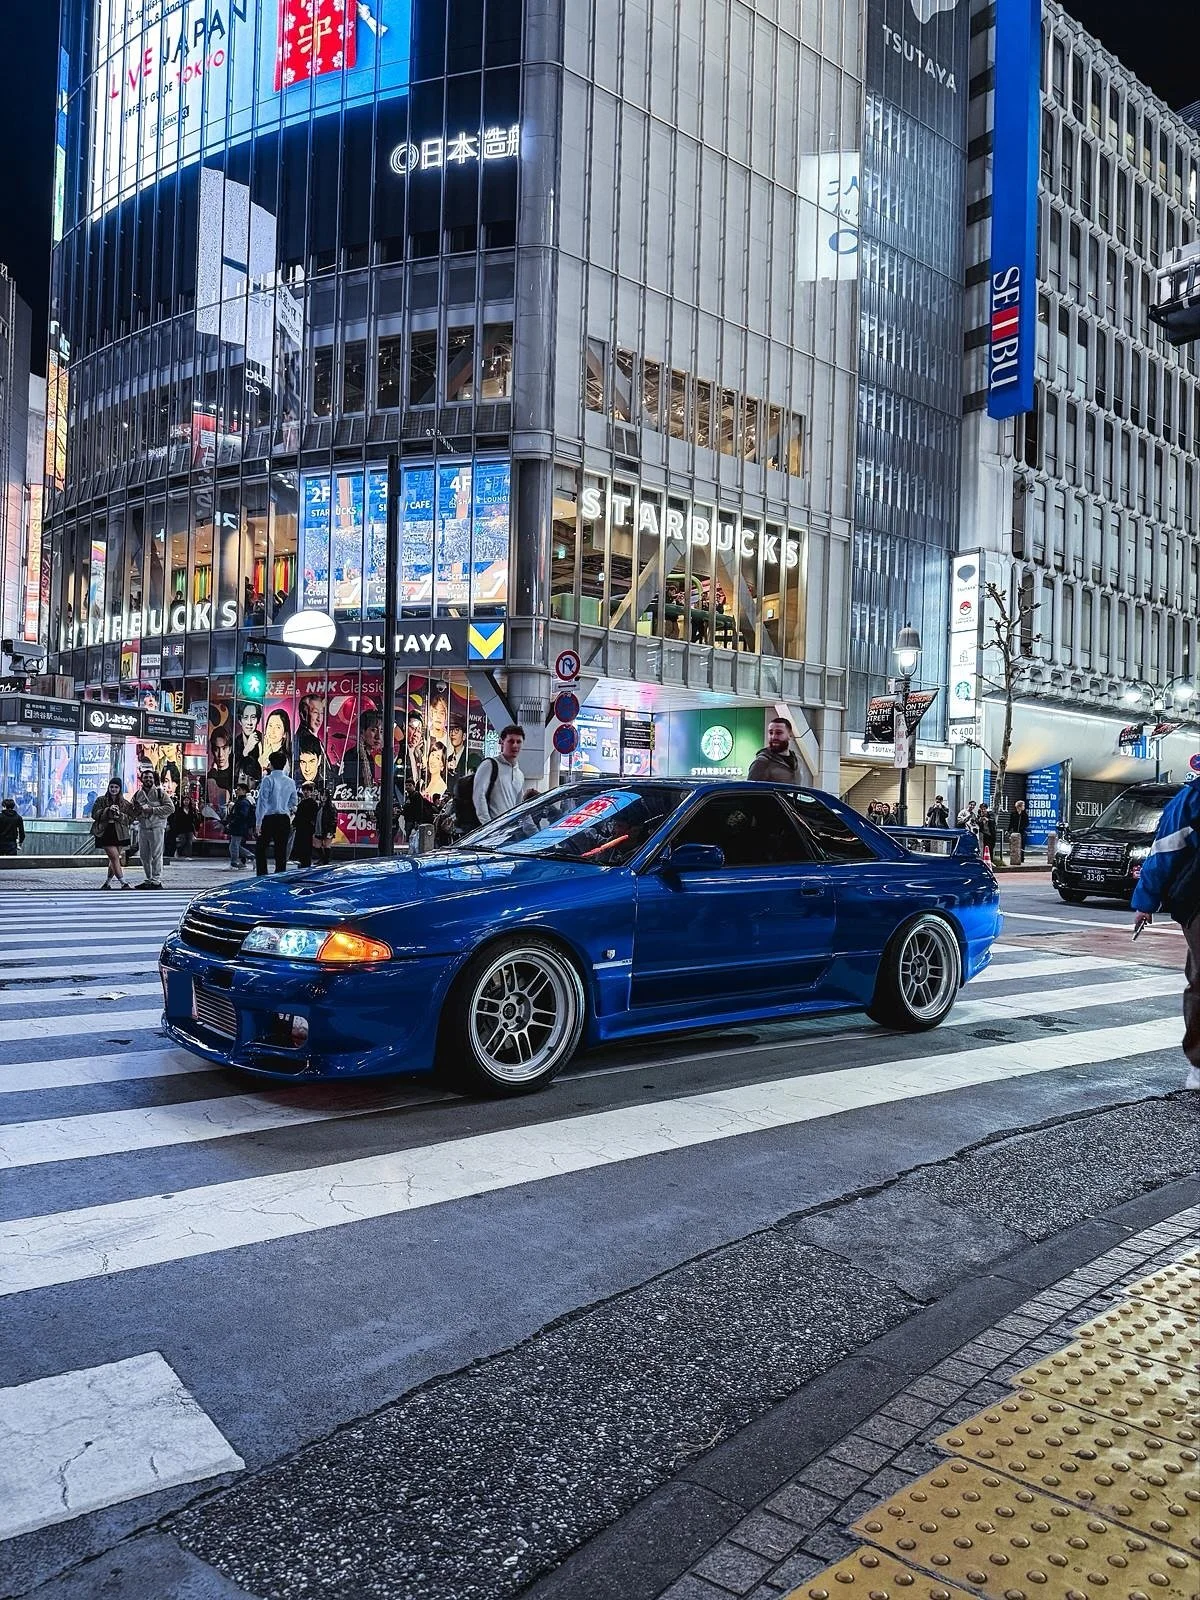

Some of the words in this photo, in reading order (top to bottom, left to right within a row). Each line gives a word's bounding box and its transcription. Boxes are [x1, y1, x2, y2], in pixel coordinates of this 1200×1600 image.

[882, 24, 957, 94] TSUTAYA
[110, 47, 153, 98] LVE
[150, 81, 174, 102] GUDE
[176, 49, 225, 85] TOKYO
[990, 266, 1020, 392] SEIBU
[449, 475, 472, 493] 4F
[311, 486, 331, 503] 2F
[458, 496, 482, 505] SHAE
[311, 506, 357, 518] STARUCKS
[582, 486, 800, 569] STARBUCKS
[446, 571, 482, 582] Scramle
[307, 578, 341, 588] Scrame
[446, 581, 481, 592] Crossg
[308, 587, 340, 597] Crossg
[67, 600, 238, 650] STARBUCKS
[348, 633, 453, 653] TSUTAYA
[306, 681, 338, 693] NHK
[867, 714, 890, 722] STREET
[691, 767, 744, 777] STARBUCKS
[1050, 793, 1057, 801] to
[1028, 801, 1051, 809] SEIBU
[1075, 801, 1103, 818] SEIBU
